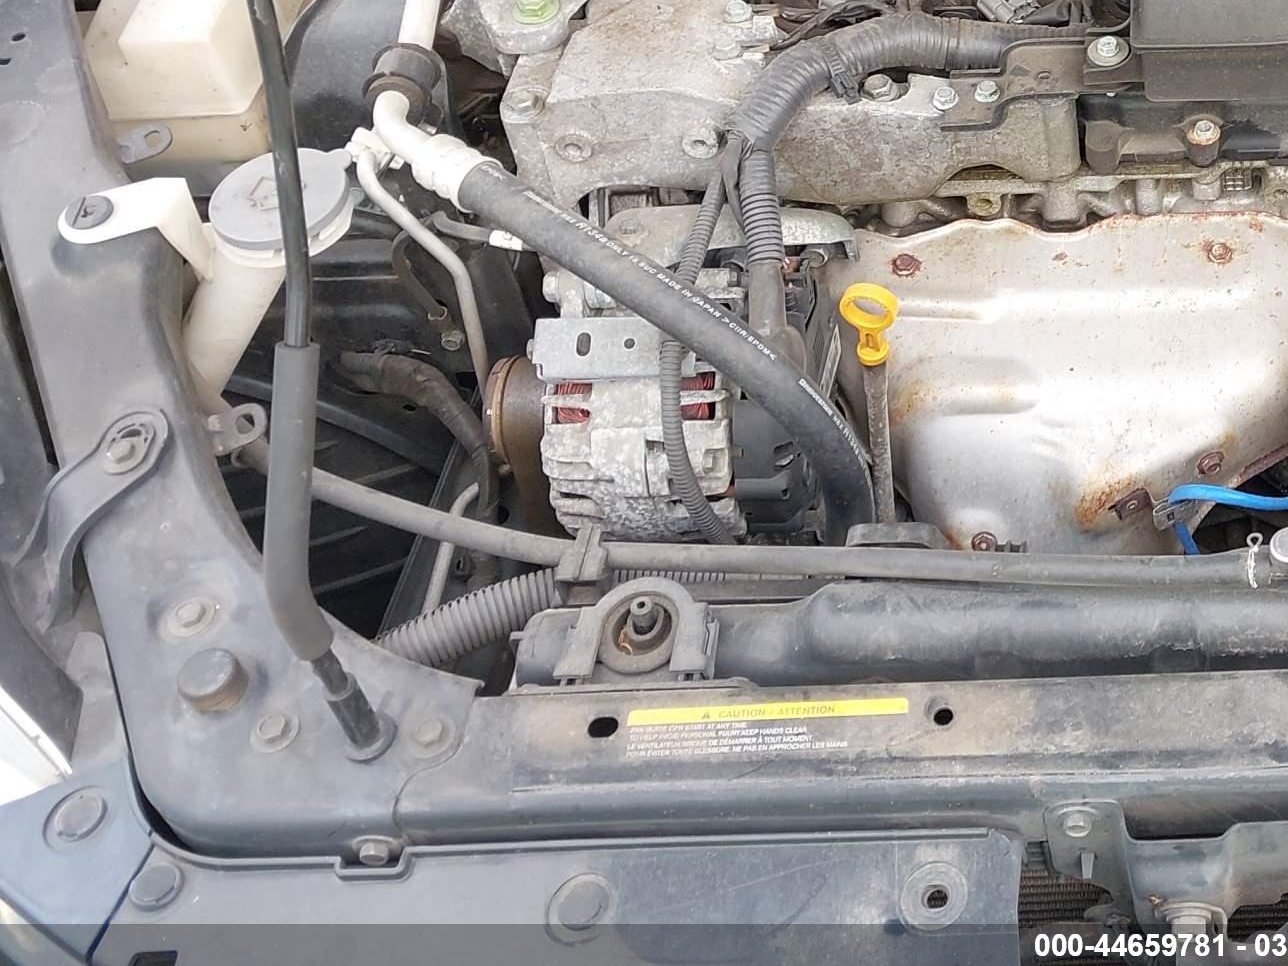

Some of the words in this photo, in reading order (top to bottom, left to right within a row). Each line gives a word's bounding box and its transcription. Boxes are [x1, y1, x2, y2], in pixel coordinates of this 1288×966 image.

[657, 273, 681, 290] MADE
[681, 289, 692, 298] IN
[692, 297, 721, 317] JAPAN
[718, 708, 766, 718] CAUTION
[777, 705, 835, 715] ATTENTION
[685, 723, 705, 731] START
[681, 730, 717, 739] PERSONAL
[637, 740, 680, 750] VENTILATEUR
[764, 735, 781, 743] TOUT
[768, 742, 811, 750] APPROCHER
